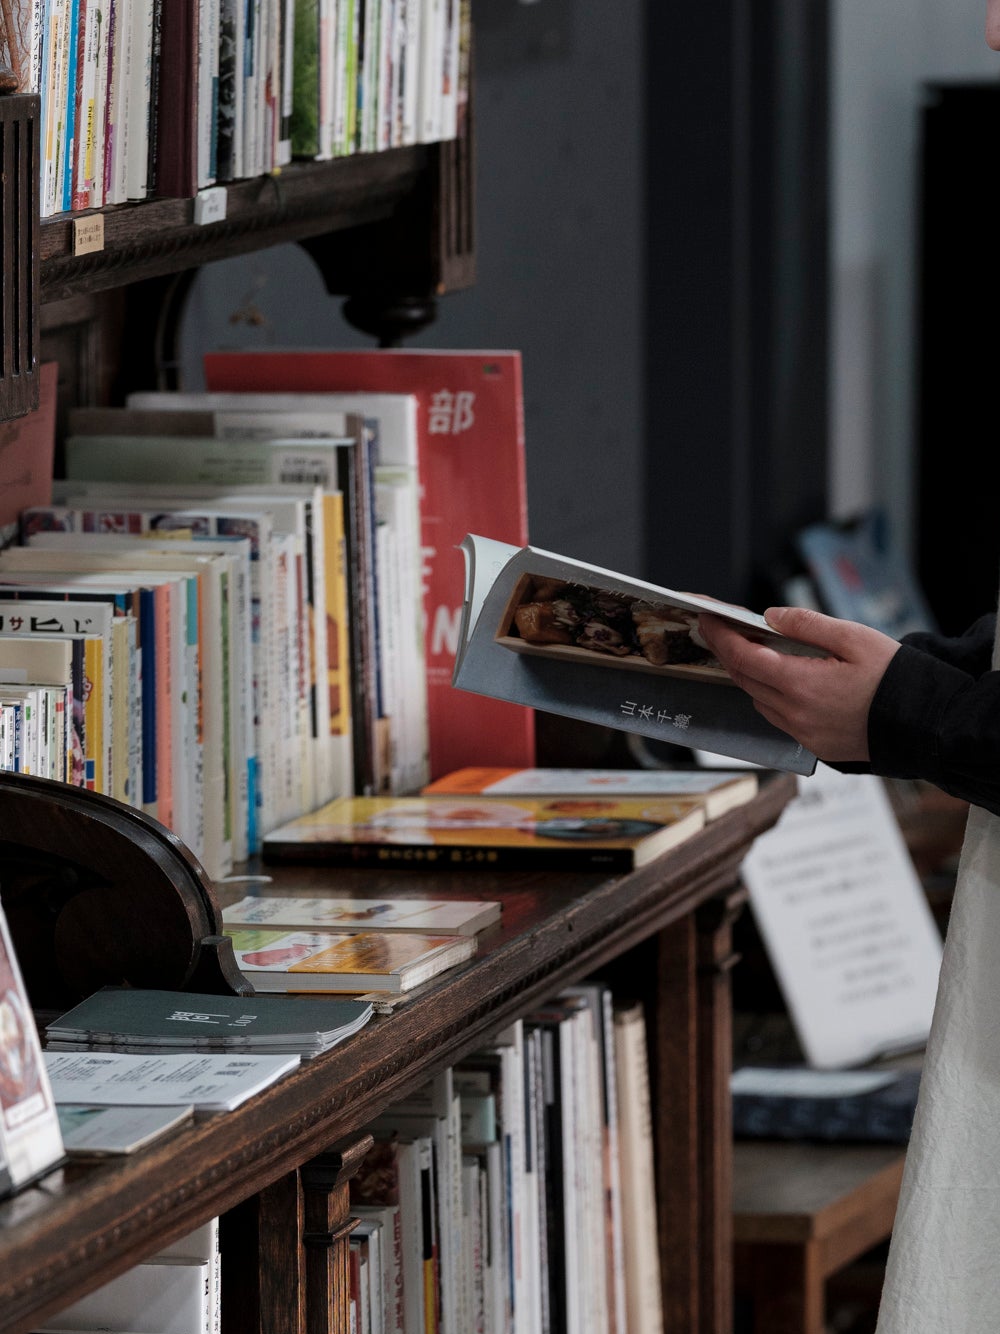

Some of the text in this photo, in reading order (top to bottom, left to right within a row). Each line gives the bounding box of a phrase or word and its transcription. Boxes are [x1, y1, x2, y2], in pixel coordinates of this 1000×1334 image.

[428, 388, 476, 435] 部
[620, 701, 692, 730] 山本千織
[164, 1011, 230, 1024] 問
